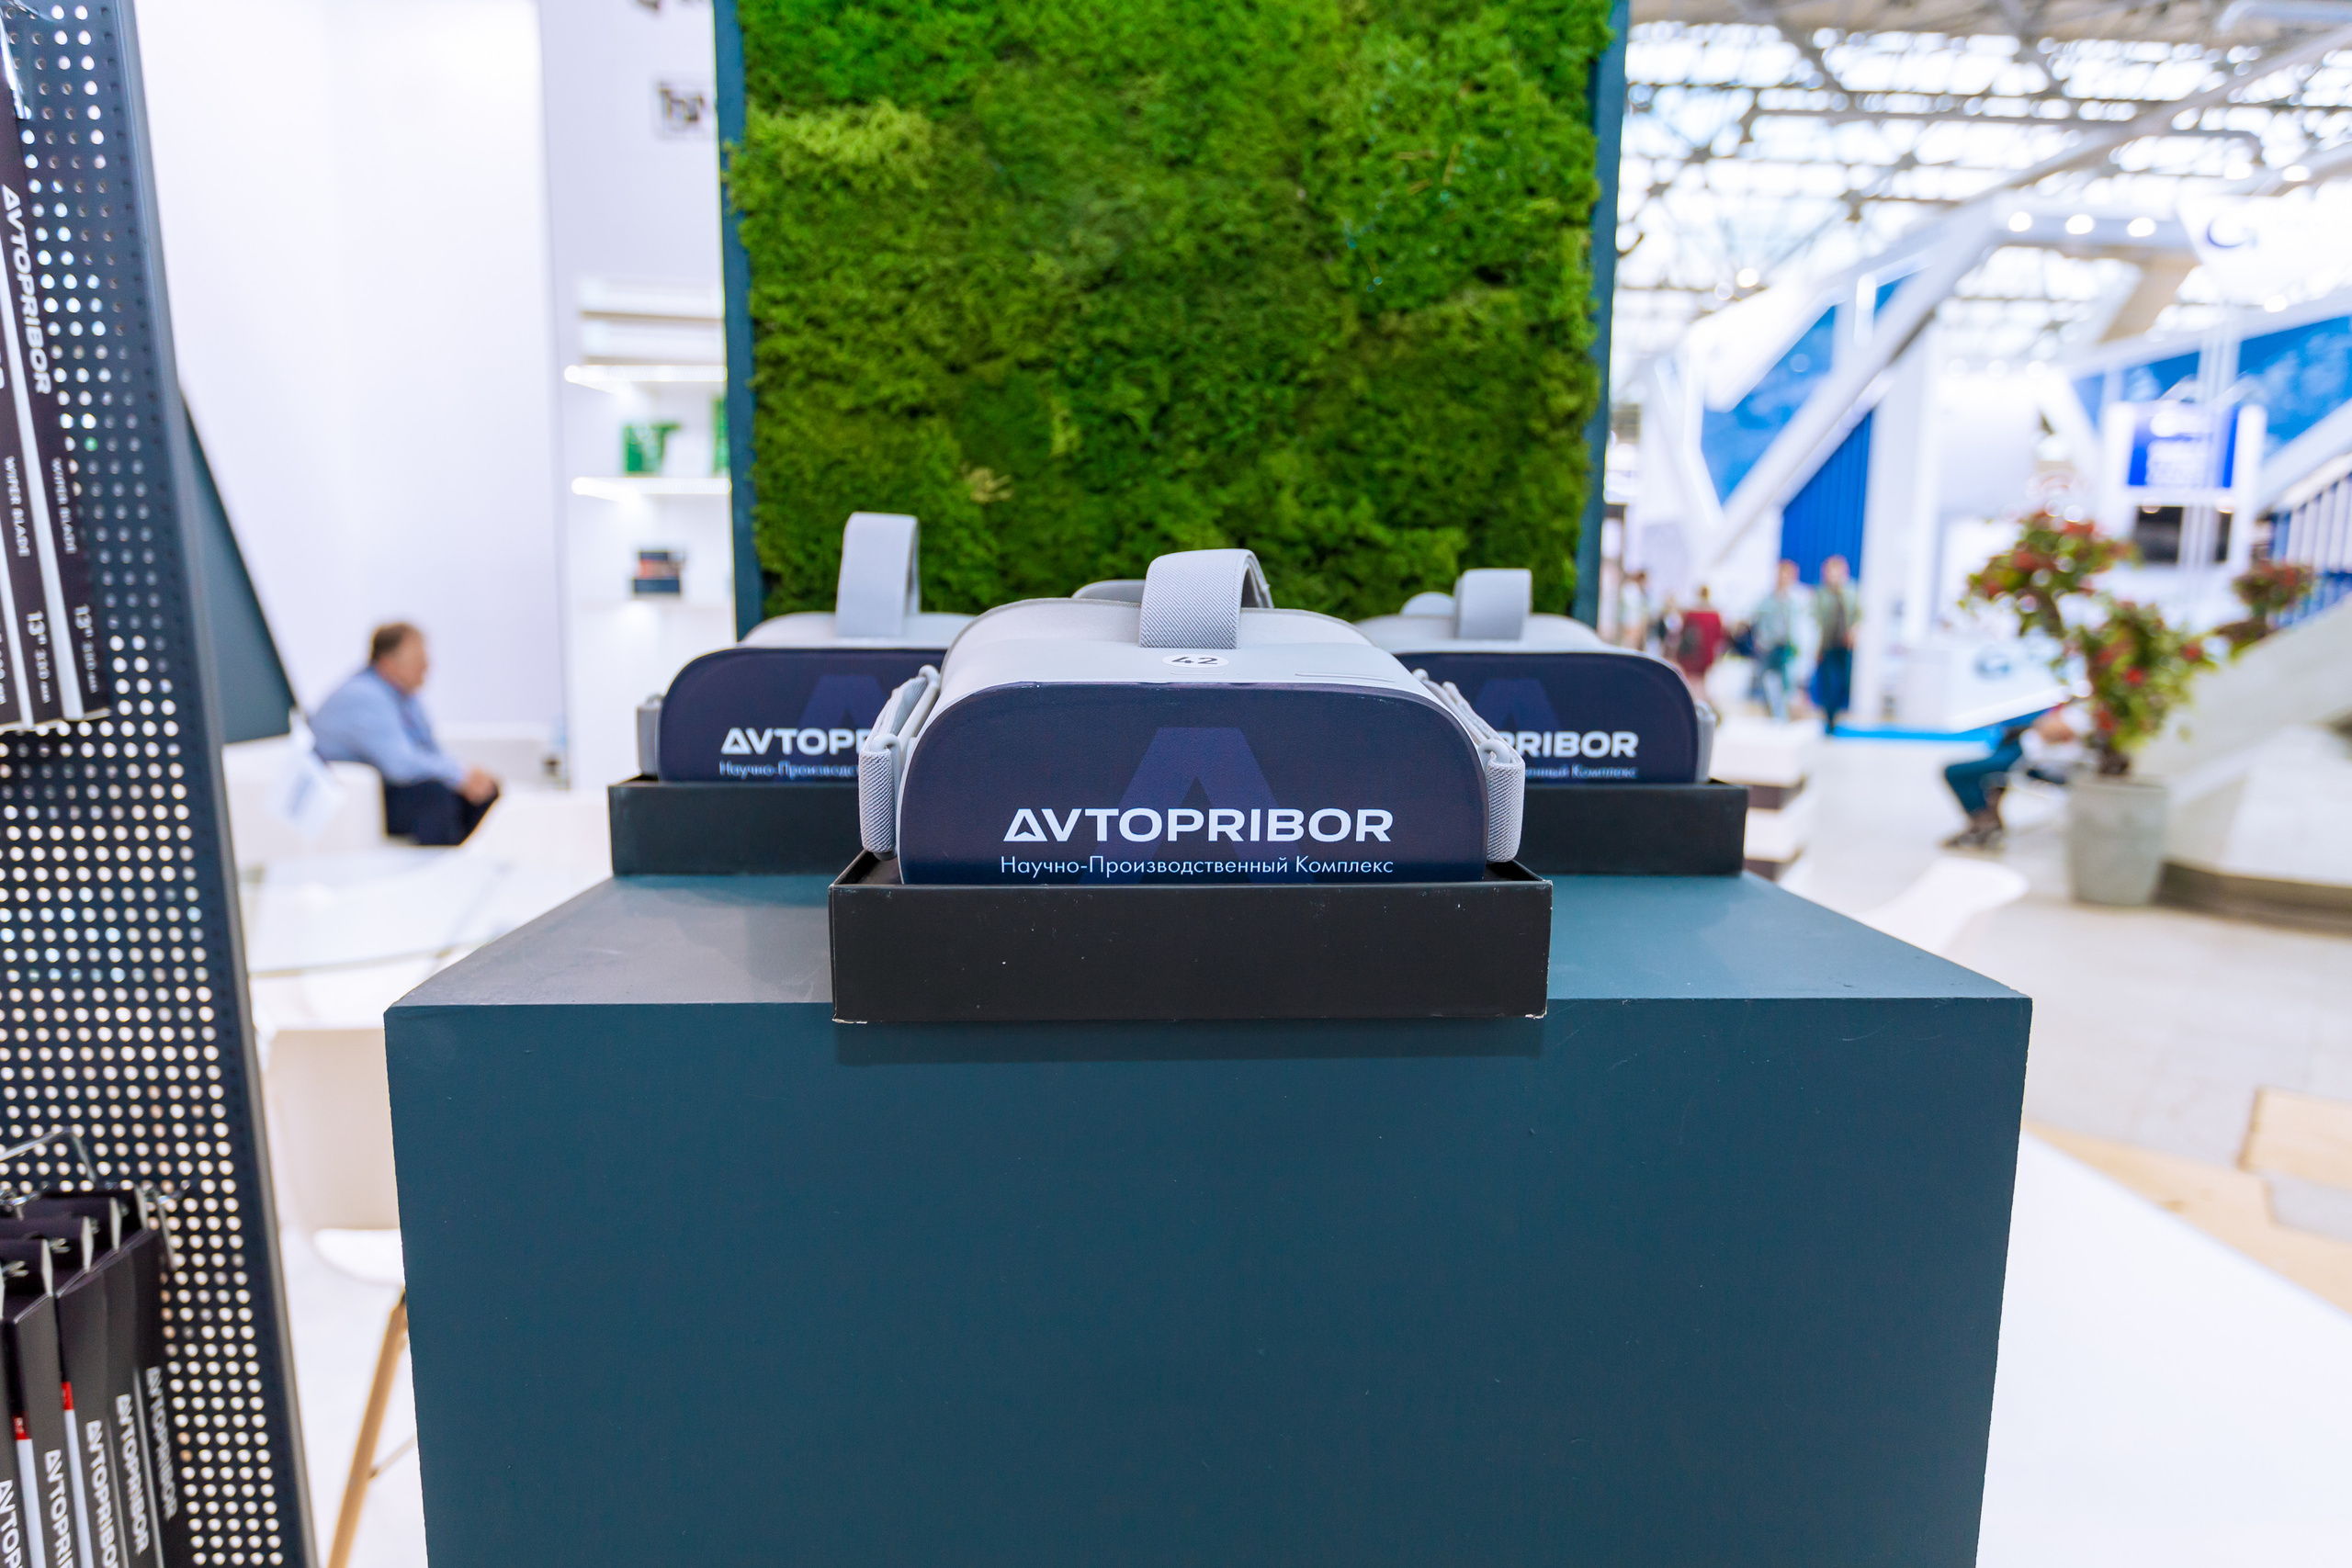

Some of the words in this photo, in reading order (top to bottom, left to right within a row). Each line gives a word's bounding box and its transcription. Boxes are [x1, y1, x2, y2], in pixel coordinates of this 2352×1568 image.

[2, 185, 51, 394] AVTOPRIBOR
[4, 456, 22, 505] WIPER
[11, 507, 30, 557] BLADE
[1171, 656, 1218, 665] 42
[1002, 807, 1394, 842] AVTOPRIBOR
[1001, 855, 1288, 878] Научно-Производственный
[1295, 855, 1394, 873] Комплекс
[146, 1366, 177, 1521] AVTOPRIBOR
[116, 1393, 150, 1554] AVTOPRIBOR
